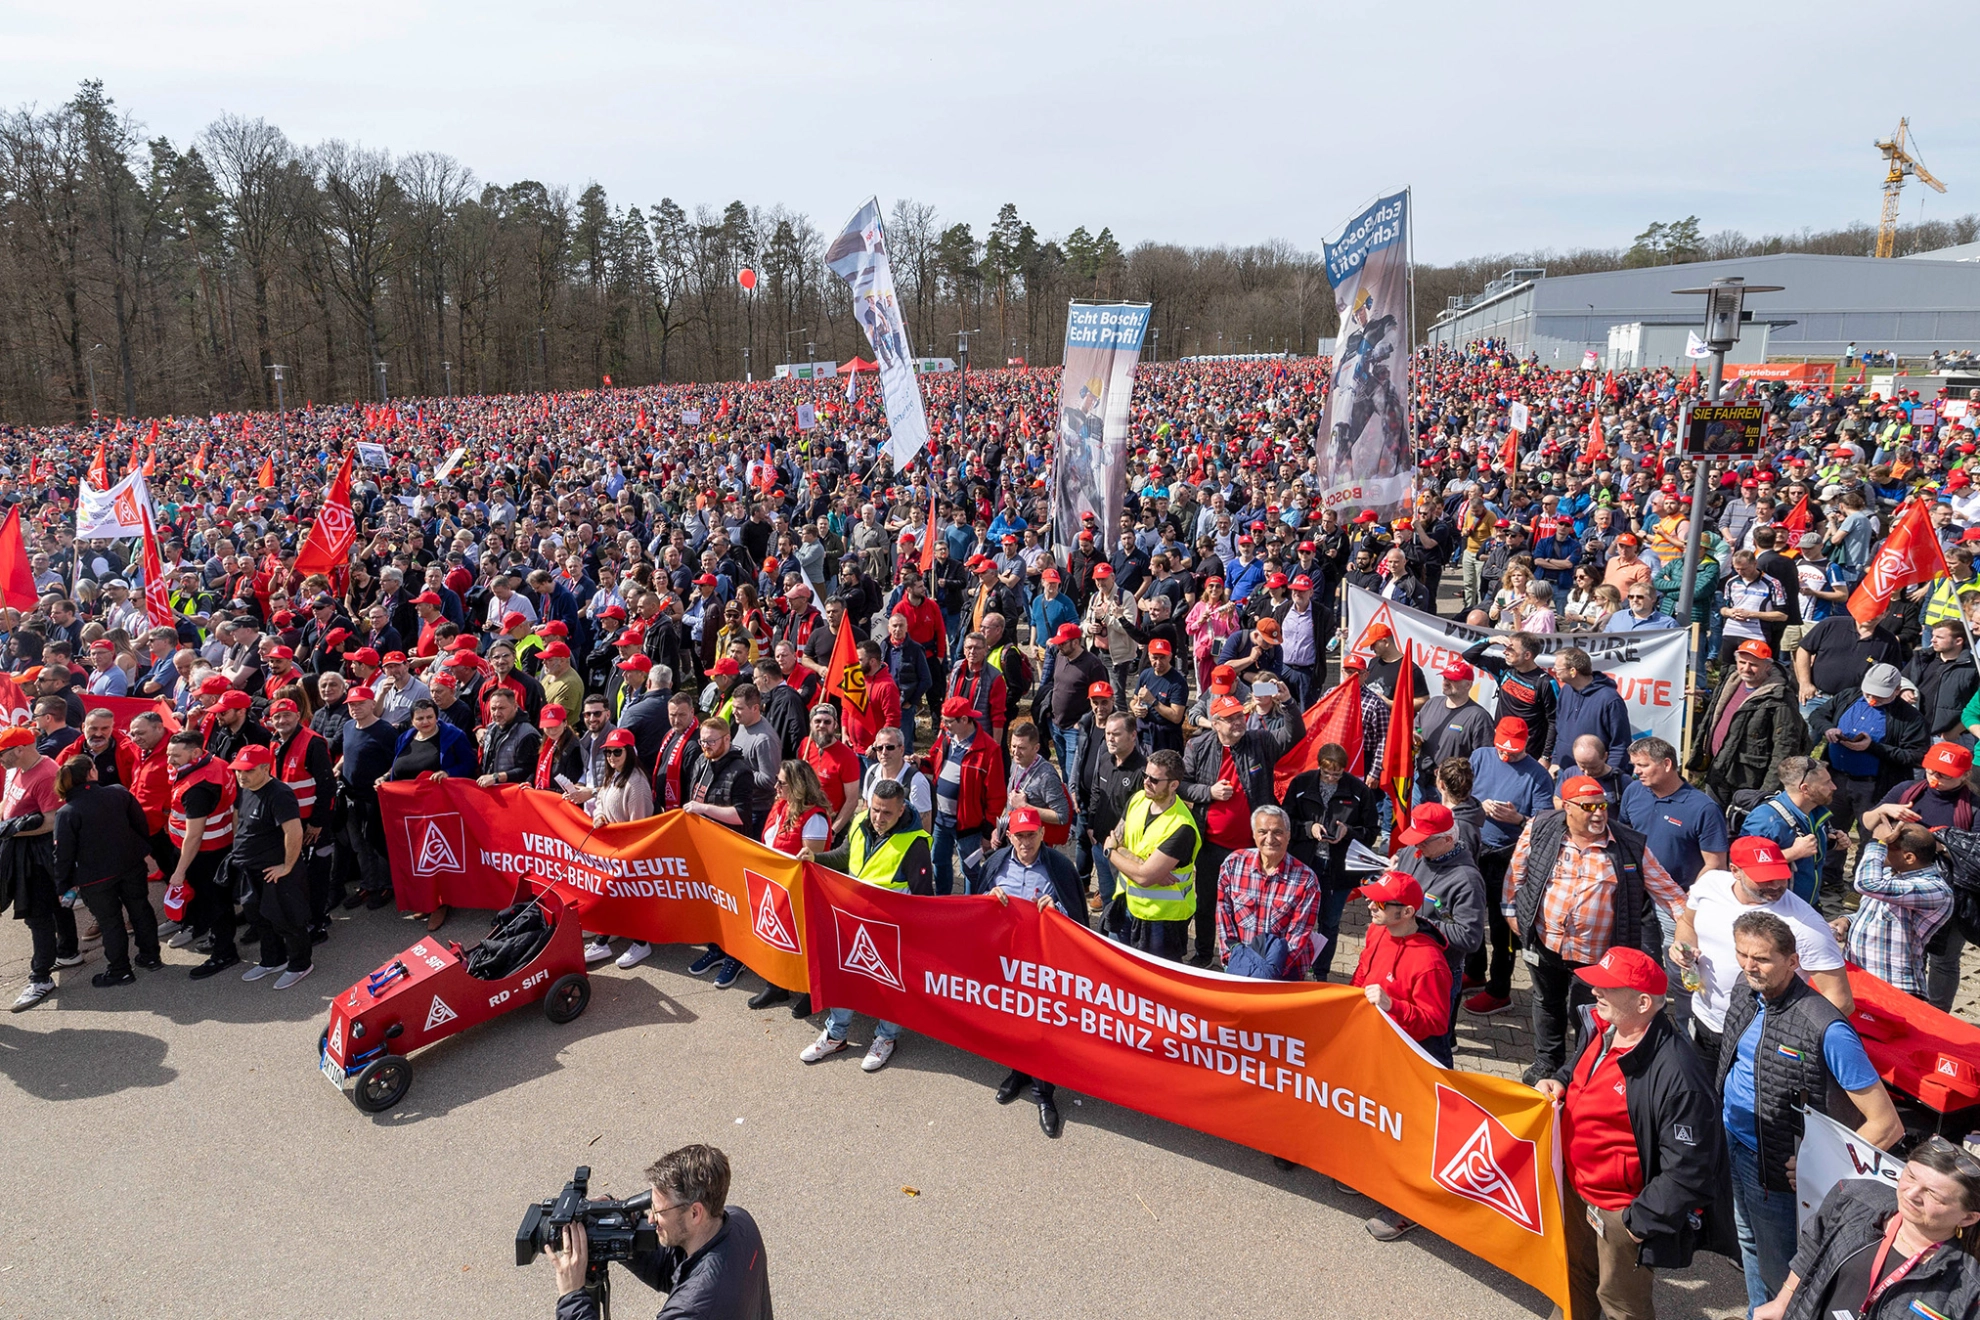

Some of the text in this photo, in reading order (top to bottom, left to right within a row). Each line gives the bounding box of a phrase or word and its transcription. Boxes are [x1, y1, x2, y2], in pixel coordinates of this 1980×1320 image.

[1070, 326, 1140, 345] Echt Profi!
[1071, 311, 1144, 327] Echt Bosch!
[1693, 407, 1762, 420] SIE FAHREN
[1745, 425, 1760, 435] km
[521, 831, 690, 878] VERTRAUENSLEUTE
[480, 848, 739, 916] MERCEDES-BENZ SINDELFINGEN
[411, 943, 427, 960] RD
[425, 953, 446, 971] SIFI
[489, 990, 510, 1008] RD
[522, 968, 550, 990] SIFI
[999, 954, 1306, 1068] VERTRAUENSLEUTE
[923, 969, 1404, 1142] MERCEDES-BENZ SINDELFINGEN
